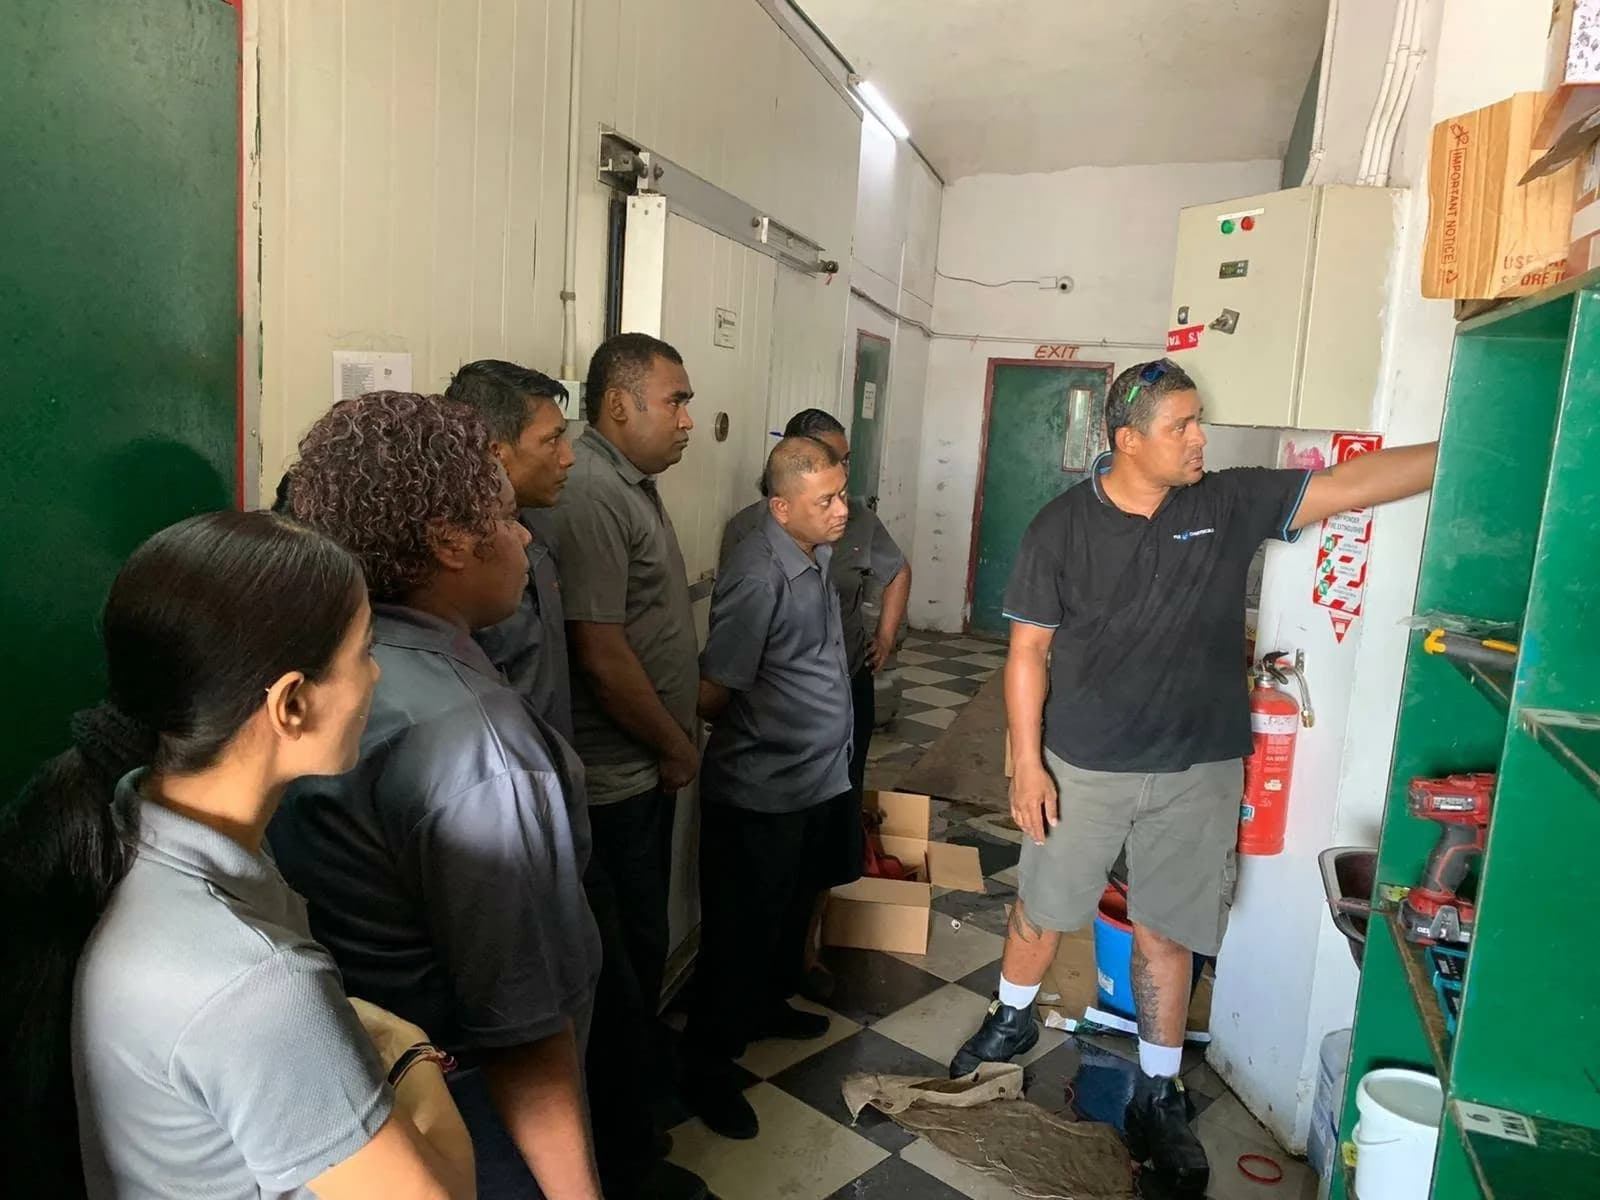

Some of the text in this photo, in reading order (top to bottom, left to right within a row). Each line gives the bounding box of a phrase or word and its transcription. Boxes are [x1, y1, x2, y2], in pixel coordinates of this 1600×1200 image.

[1444, 153, 1462, 260] IMPORTANT NOTICE
[1034, 345, 1080, 359] EXIT
